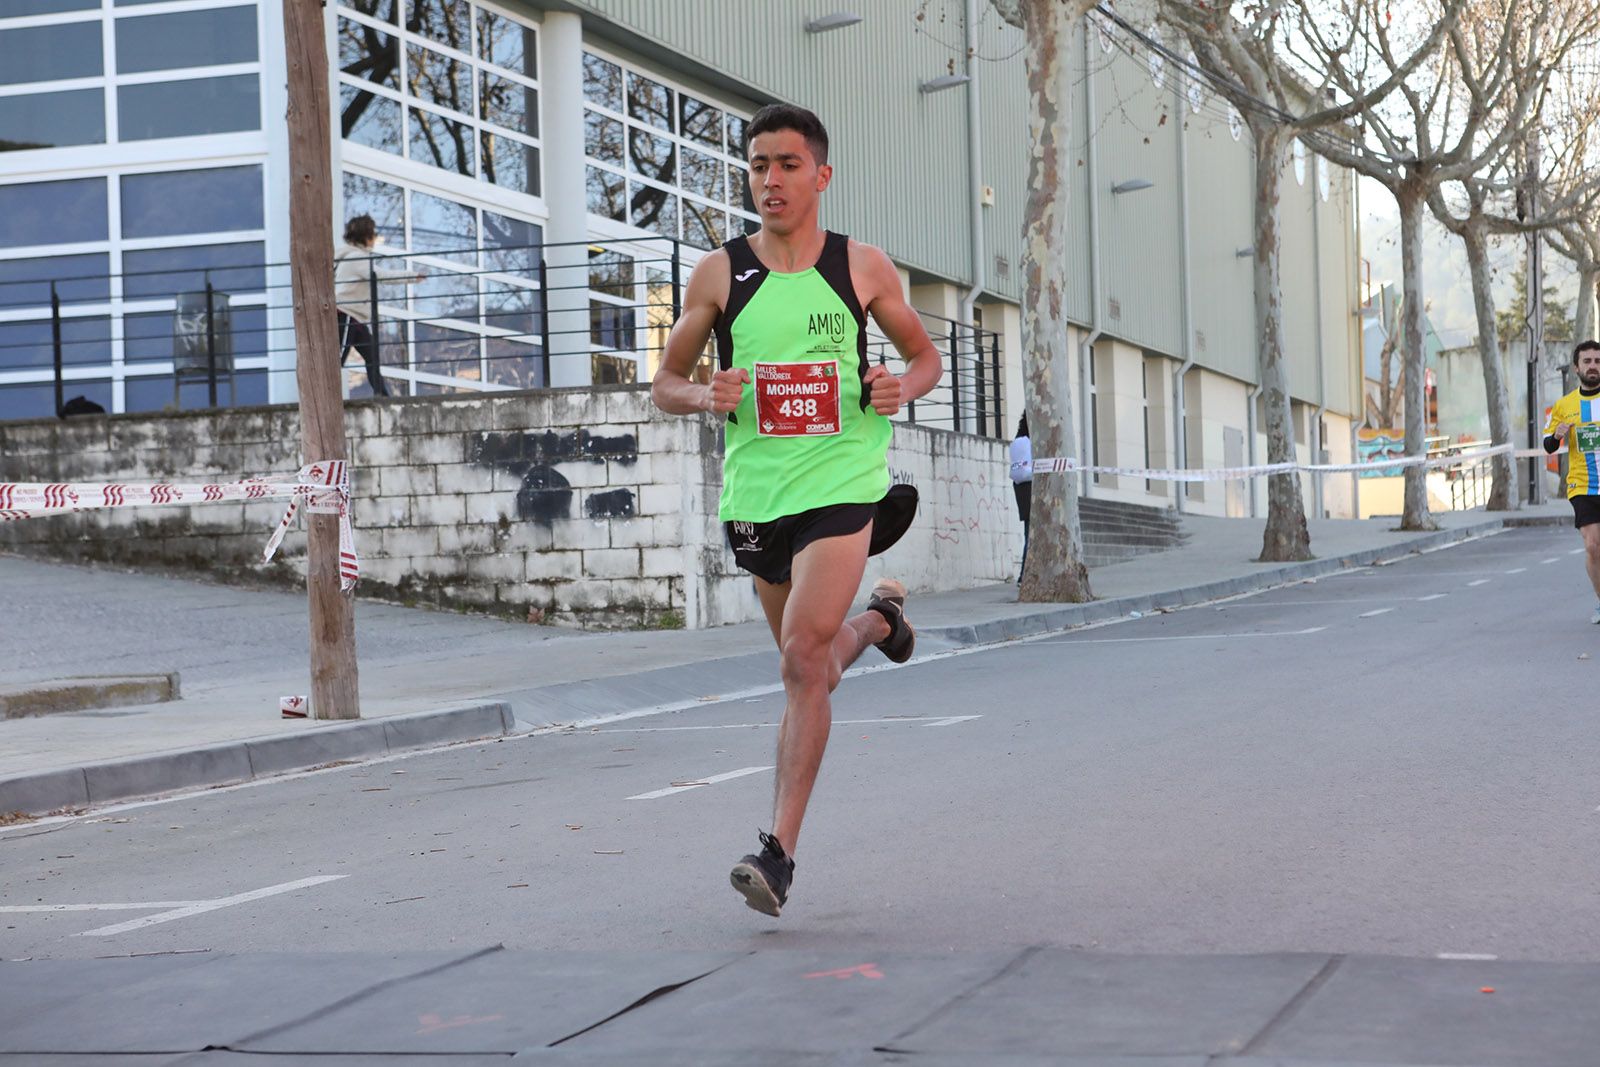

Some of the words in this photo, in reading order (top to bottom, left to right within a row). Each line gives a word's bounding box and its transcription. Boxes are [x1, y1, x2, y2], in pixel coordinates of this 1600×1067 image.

[807, 312, 845, 336] AMISI
[766, 382, 829, 396] MOHAMED
[779, 398, 817, 418] 438
